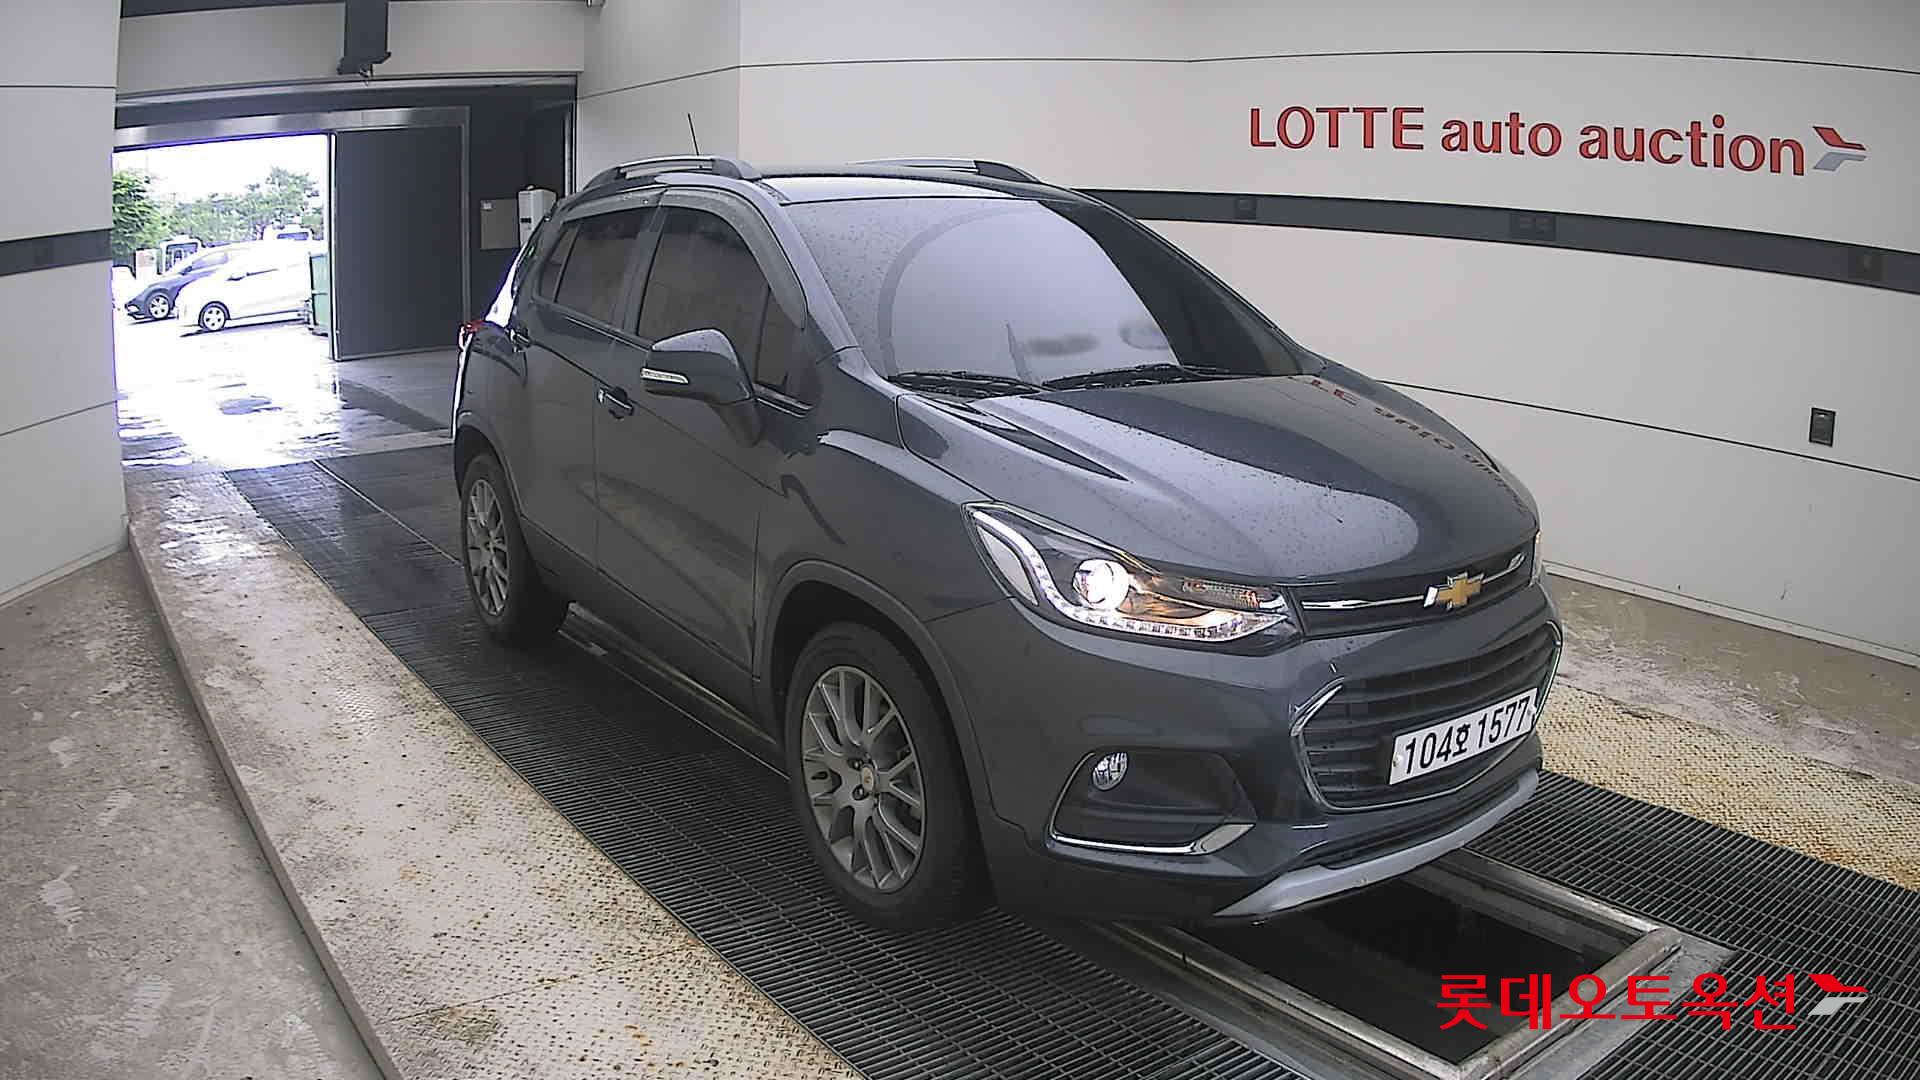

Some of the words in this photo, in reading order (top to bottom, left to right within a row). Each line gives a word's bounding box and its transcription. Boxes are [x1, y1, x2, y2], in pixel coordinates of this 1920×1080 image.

[1249, 106, 1425, 151] LOTTE
[1441, 111, 1563, 157] auto
[1578, 114, 1806, 176] auction
[1405, 723, 1471, 775] 104호
[1478, 695, 1532, 749] 1577
